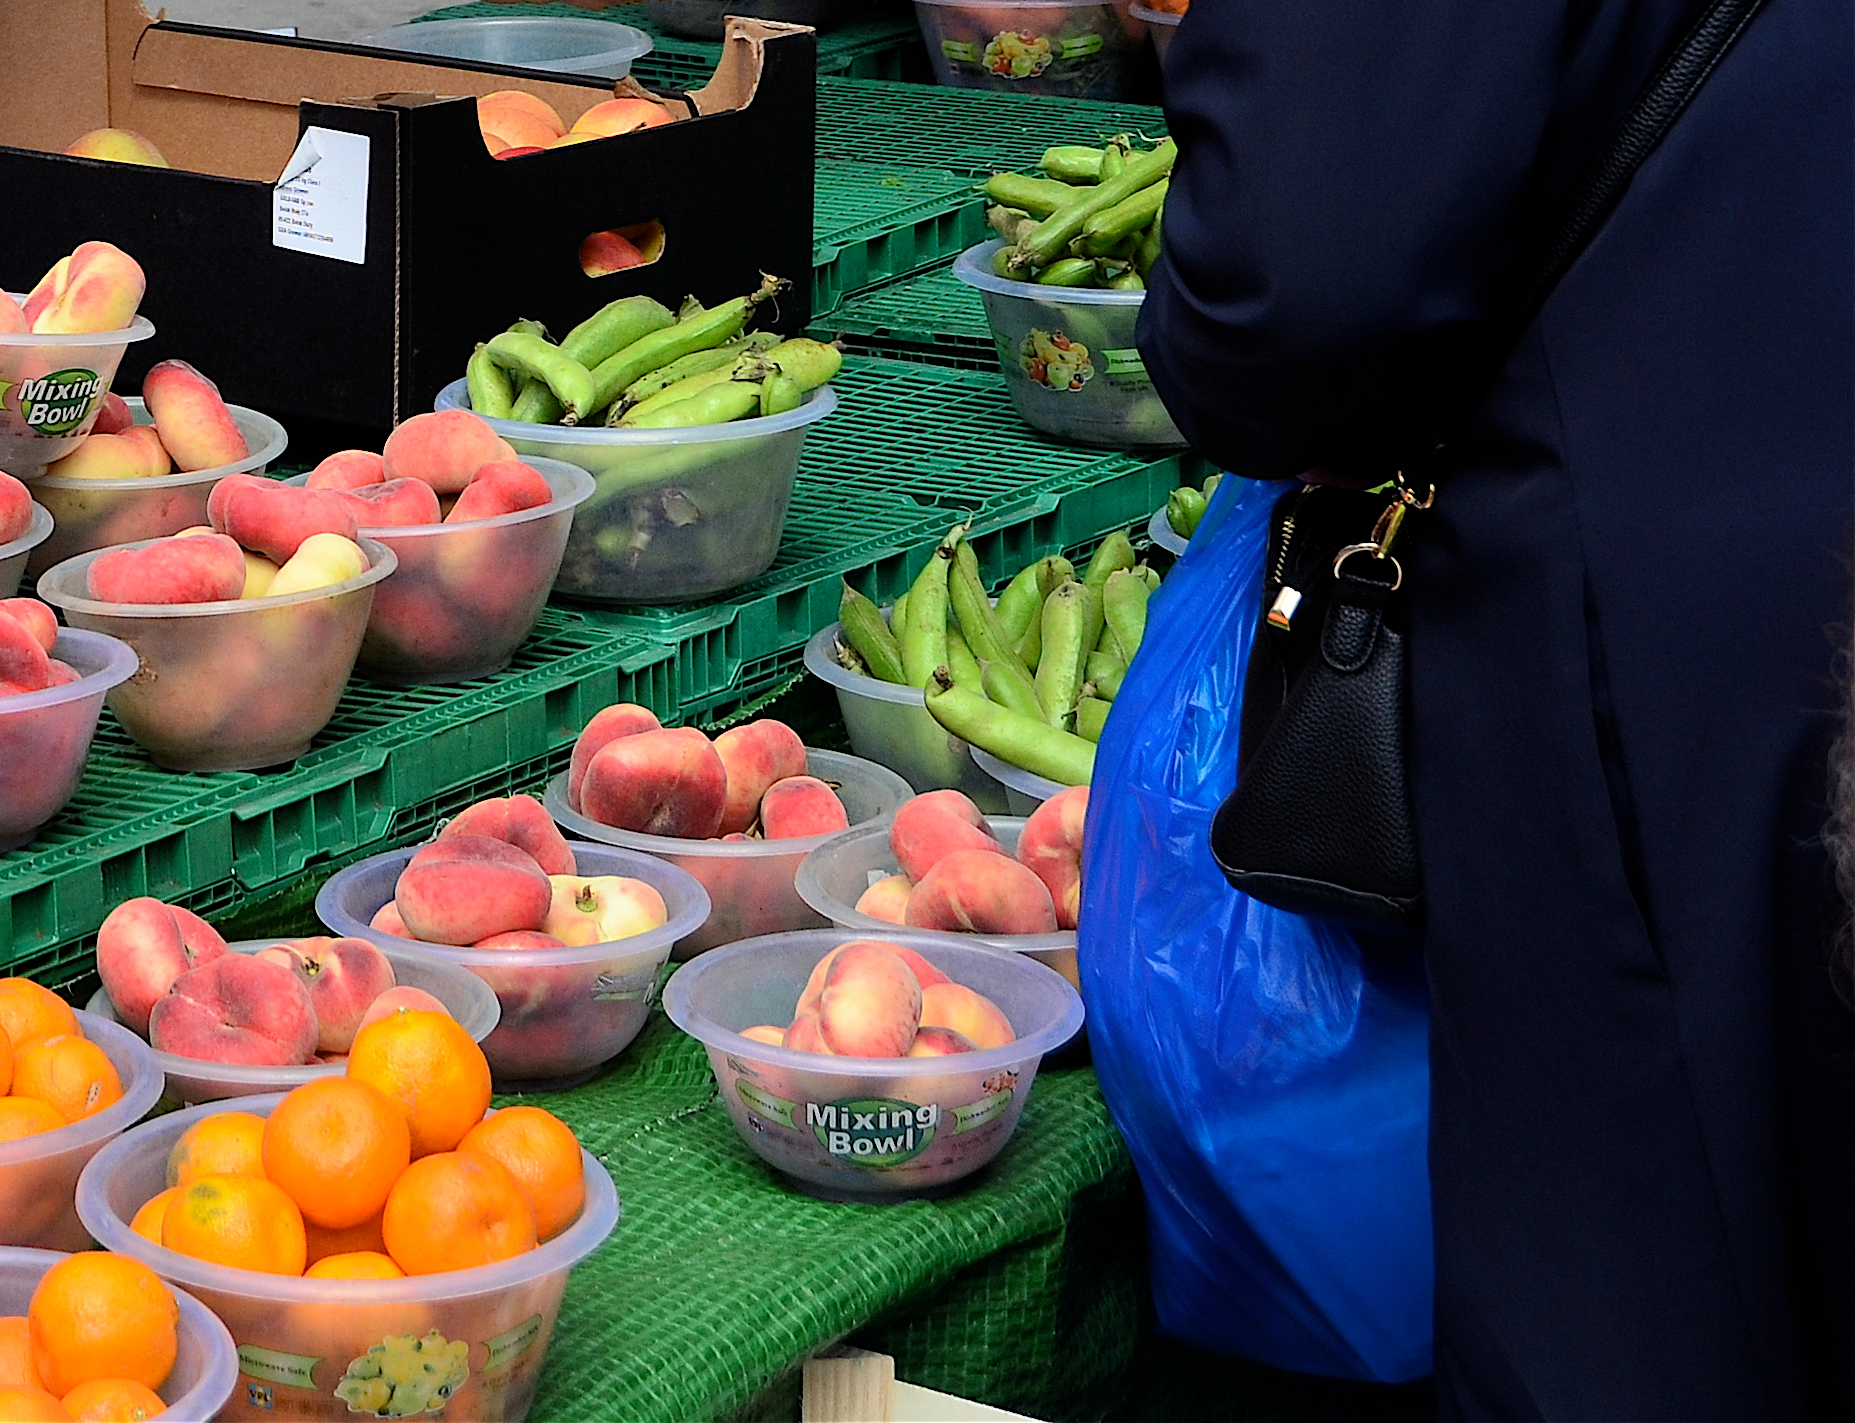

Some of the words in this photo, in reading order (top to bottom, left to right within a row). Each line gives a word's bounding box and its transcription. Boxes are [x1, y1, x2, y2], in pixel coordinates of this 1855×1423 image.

[17, 374, 105, 402] Mixing
[27, 398, 88, 427] Bowl
[806, 1101, 940, 1133] Mixing
[828, 1127, 916, 1156] Bowl
